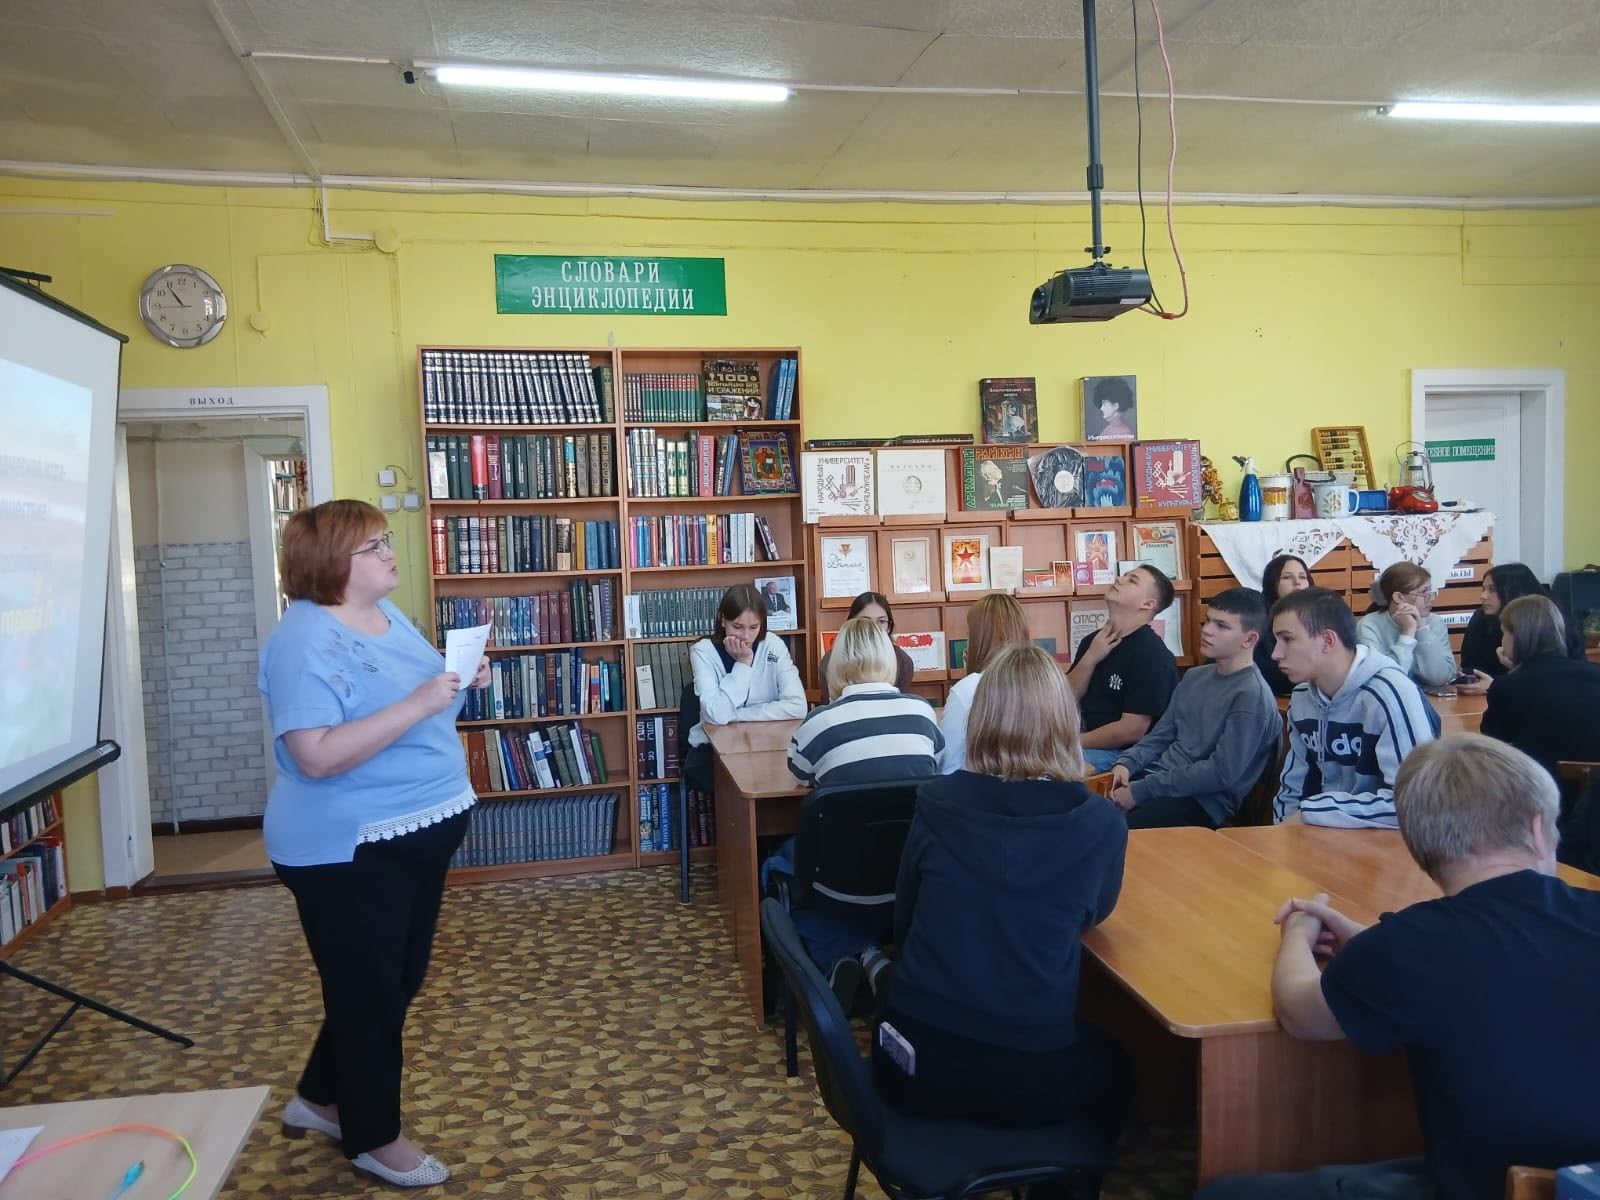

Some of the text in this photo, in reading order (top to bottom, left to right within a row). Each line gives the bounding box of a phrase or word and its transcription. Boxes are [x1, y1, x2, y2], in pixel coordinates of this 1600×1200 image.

[561, 261, 661, 284] СЛОВАРИ
[177, 278, 187, 286] 12
[193, 281, 197, 289] 1
[157, 289, 166, 297] 10
[531, 287, 694, 312] ЭНЦИКЛОПЕДИИ
[170, 323, 175, 331] 7
[182, 327, 189, 335] 6
[716, 373, 749, 382] 100
[716, 387, 760, 395] СРАЖЕНИЙ
[190, 396, 234, 406] ВЫХОД
[976, 446, 1024, 460] РАЙКИН
[1452, 445, 1495, 458] ПОМЕЩЕНИЕ
[818, 457, 865, 465] УНИВЕРСИТЕТ
[964, 448, 976, 508] АРКАДИЙ
[817, 464, 825, 504] НАРОДНЫЙ
